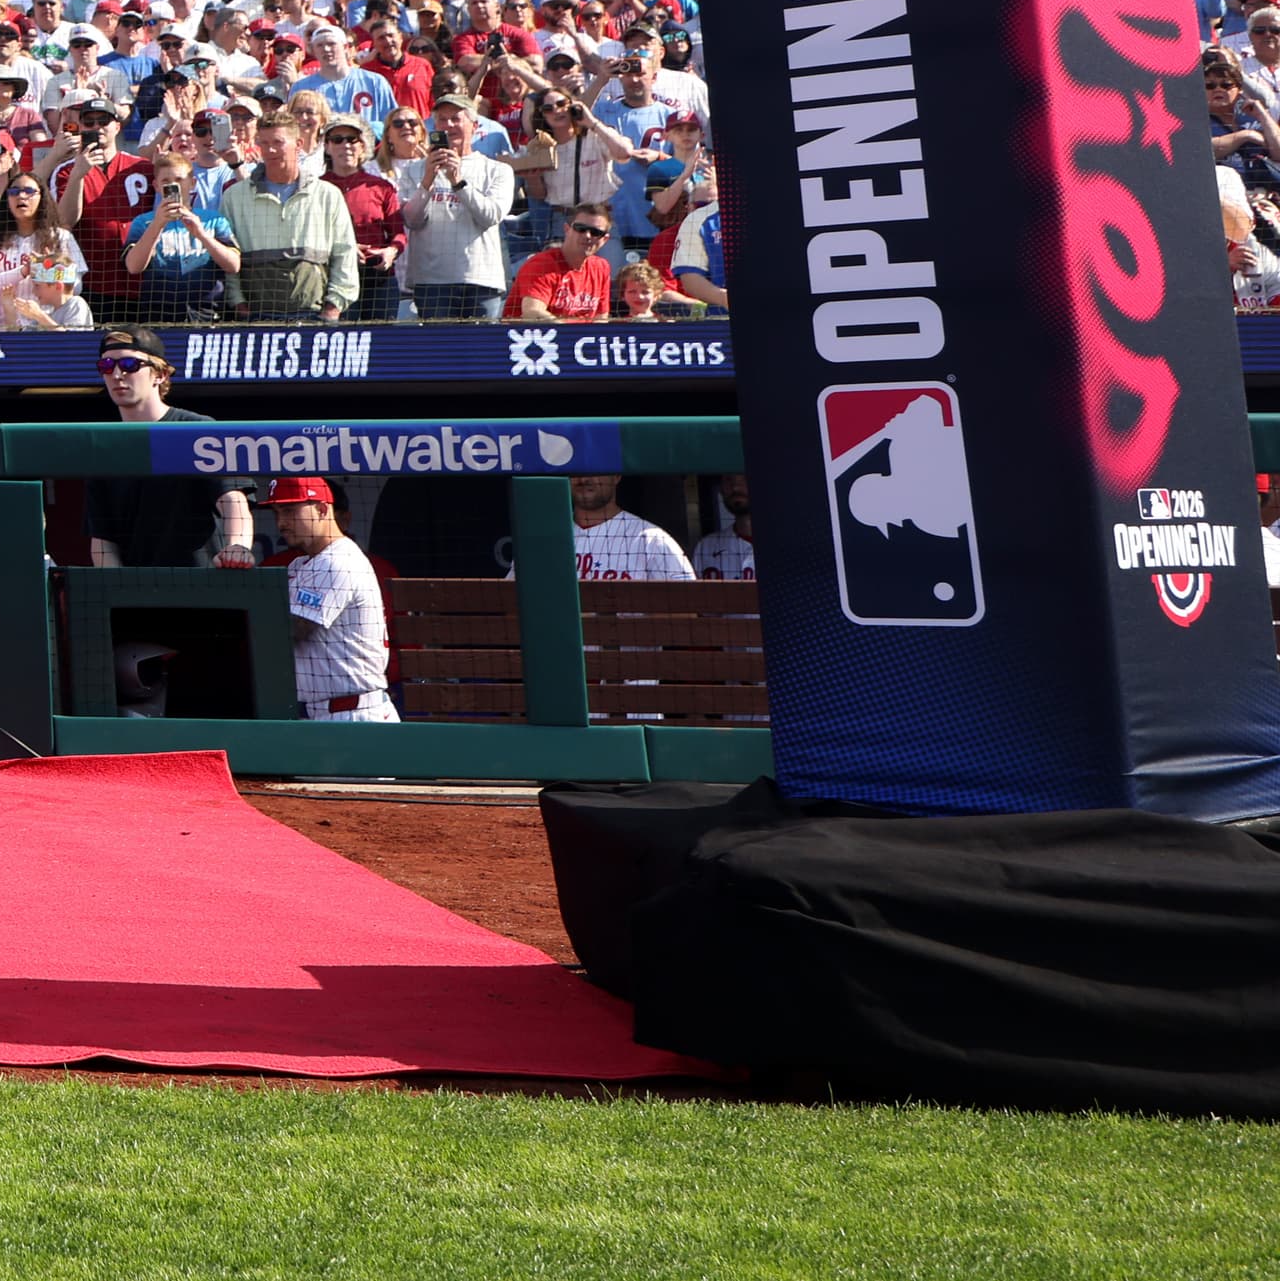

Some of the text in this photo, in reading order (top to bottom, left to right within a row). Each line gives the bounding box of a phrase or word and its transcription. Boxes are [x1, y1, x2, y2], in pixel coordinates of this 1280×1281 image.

[124, 172, 149, 208] P
[184, 330, 372, 380] PHILLIES.COM
[572, 335, 727, 367] Citizens
[192, 426, 523, 474] smartwater
[1171, 489, 1206, 518] 2026
[1113, 522, 1237, 570] OPENING DAY
[296, 590, 322, 607] IBX
